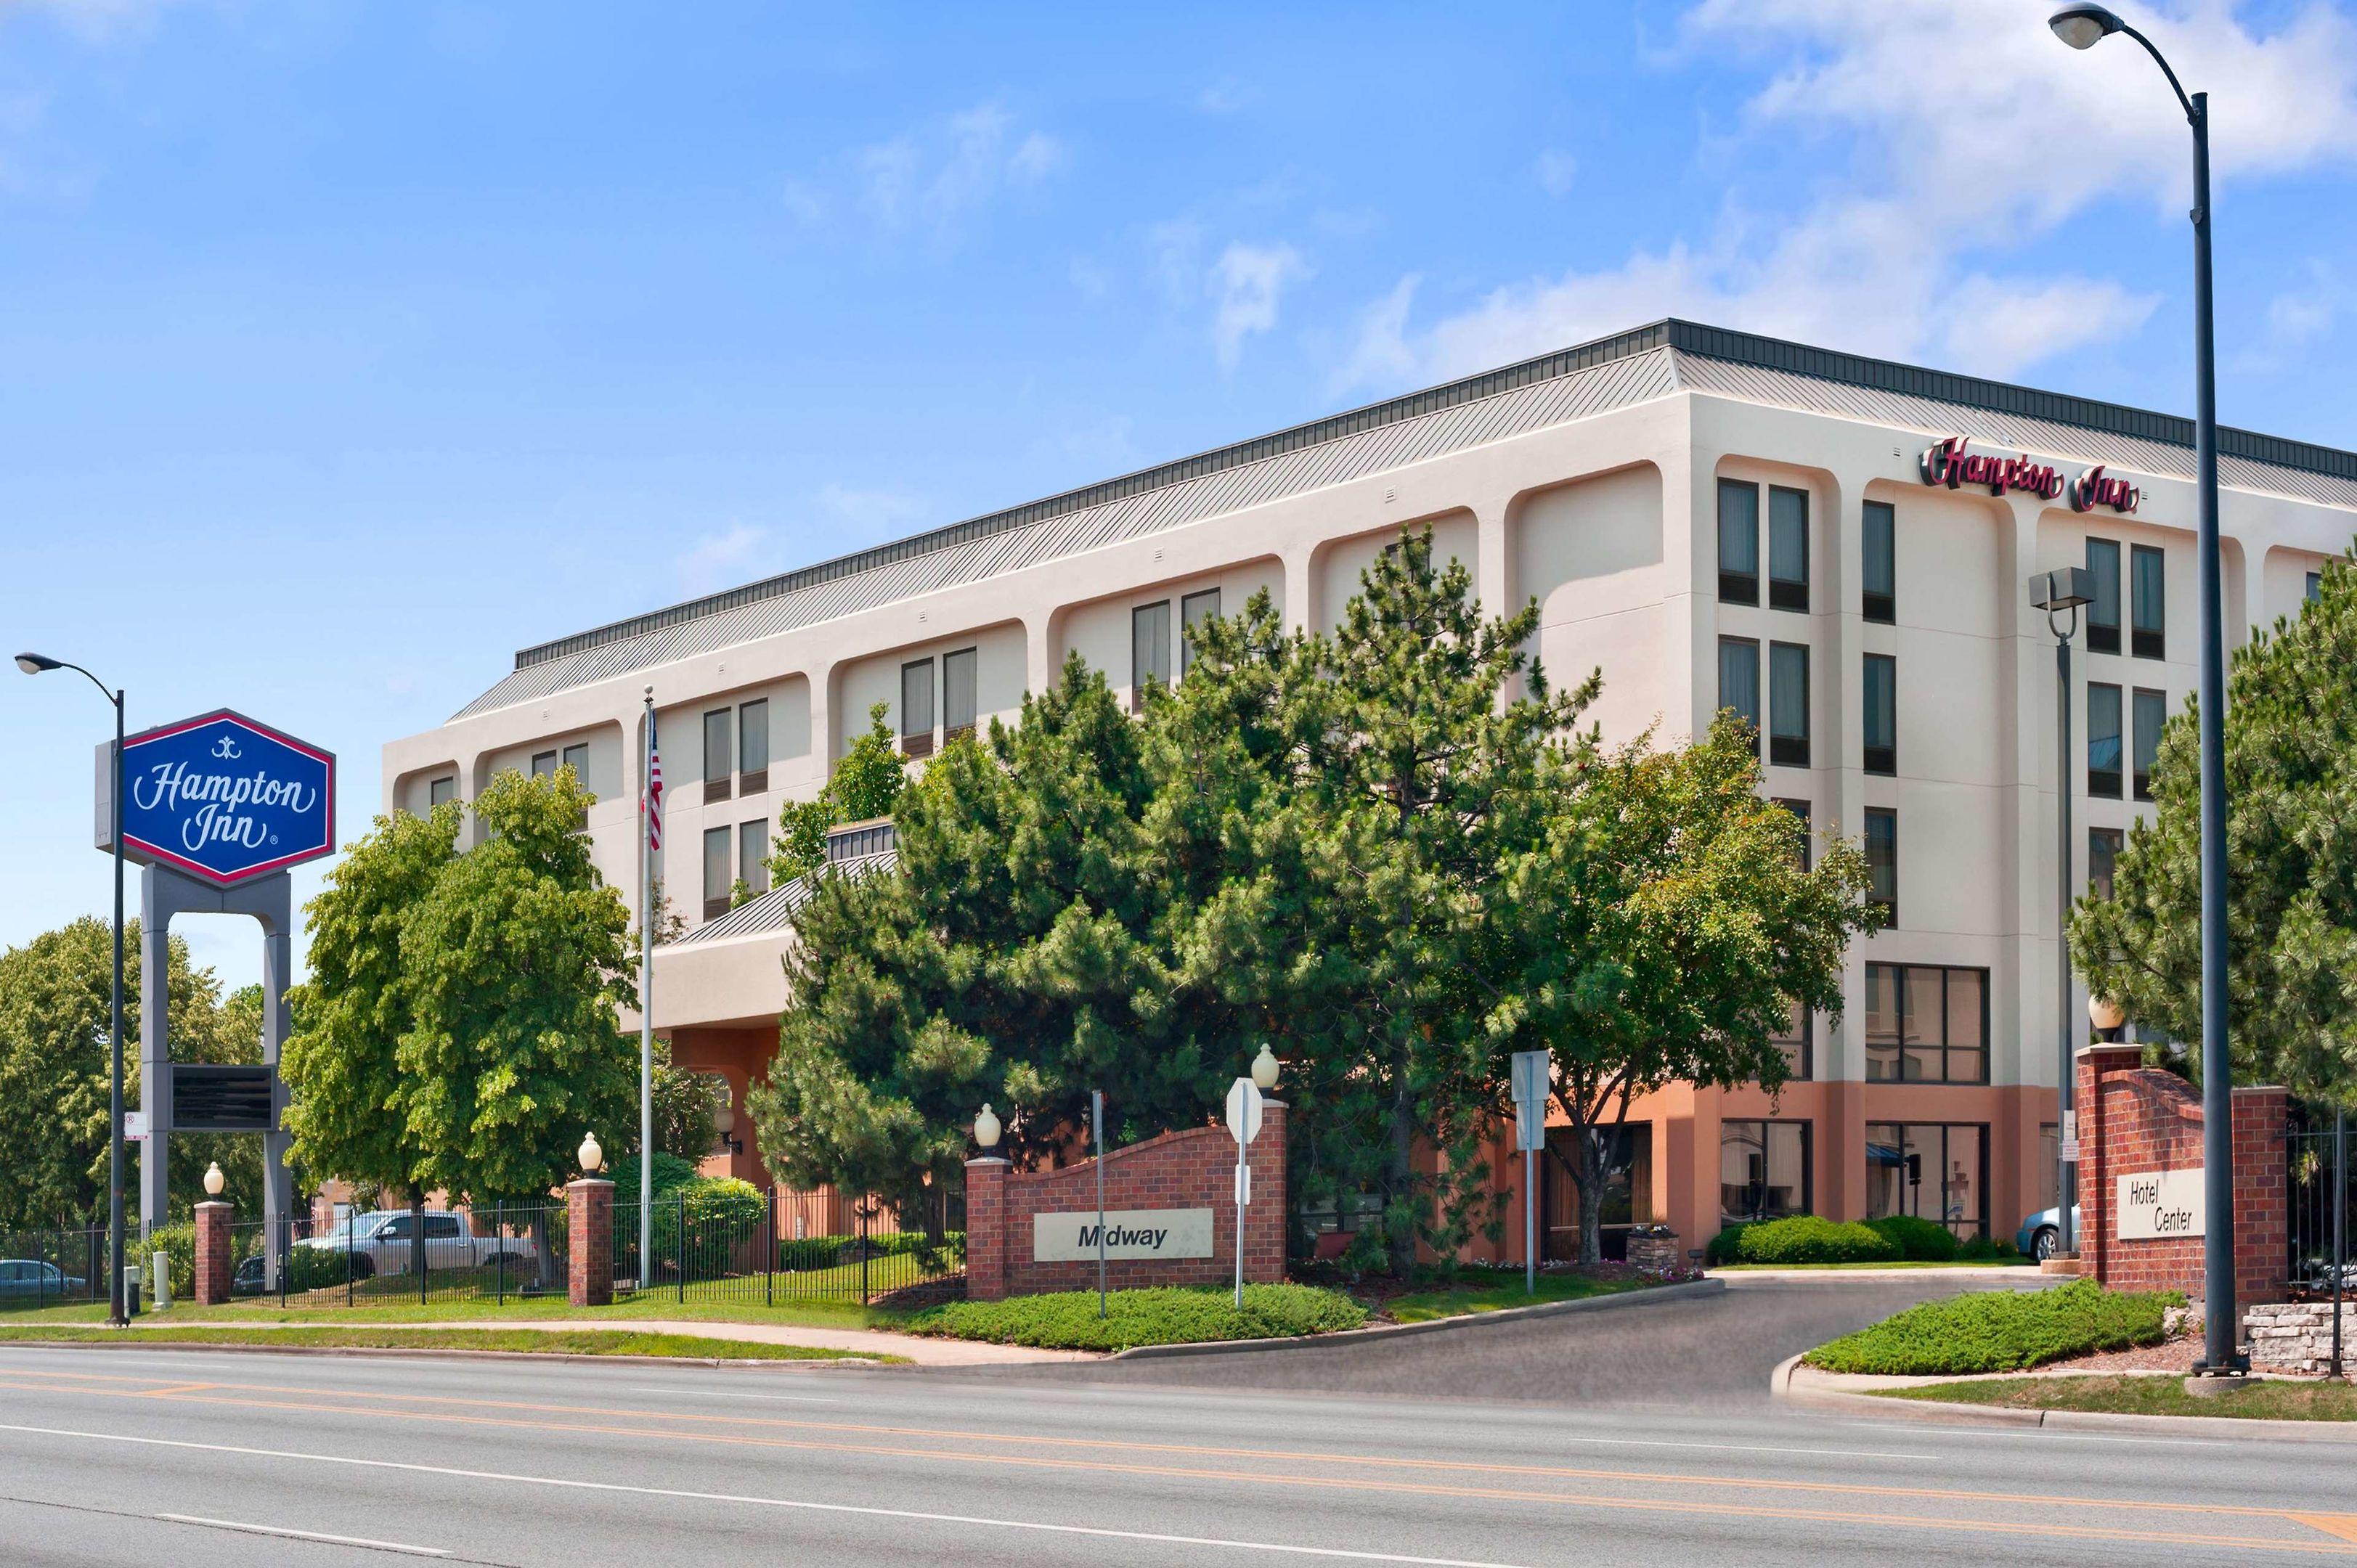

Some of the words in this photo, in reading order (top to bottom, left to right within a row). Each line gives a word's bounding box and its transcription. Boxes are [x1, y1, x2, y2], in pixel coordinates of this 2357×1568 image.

[1919, 436, 2064, 500] Hampton
[2069, 465, 2140, 513] Inn
[134, 761, 316, 814] Hampton
[182, 803, 267, 852] Inn
[2130, 1179, 2159, 1206] Hotel
[2154, 1206, 2192, 1233] Center
